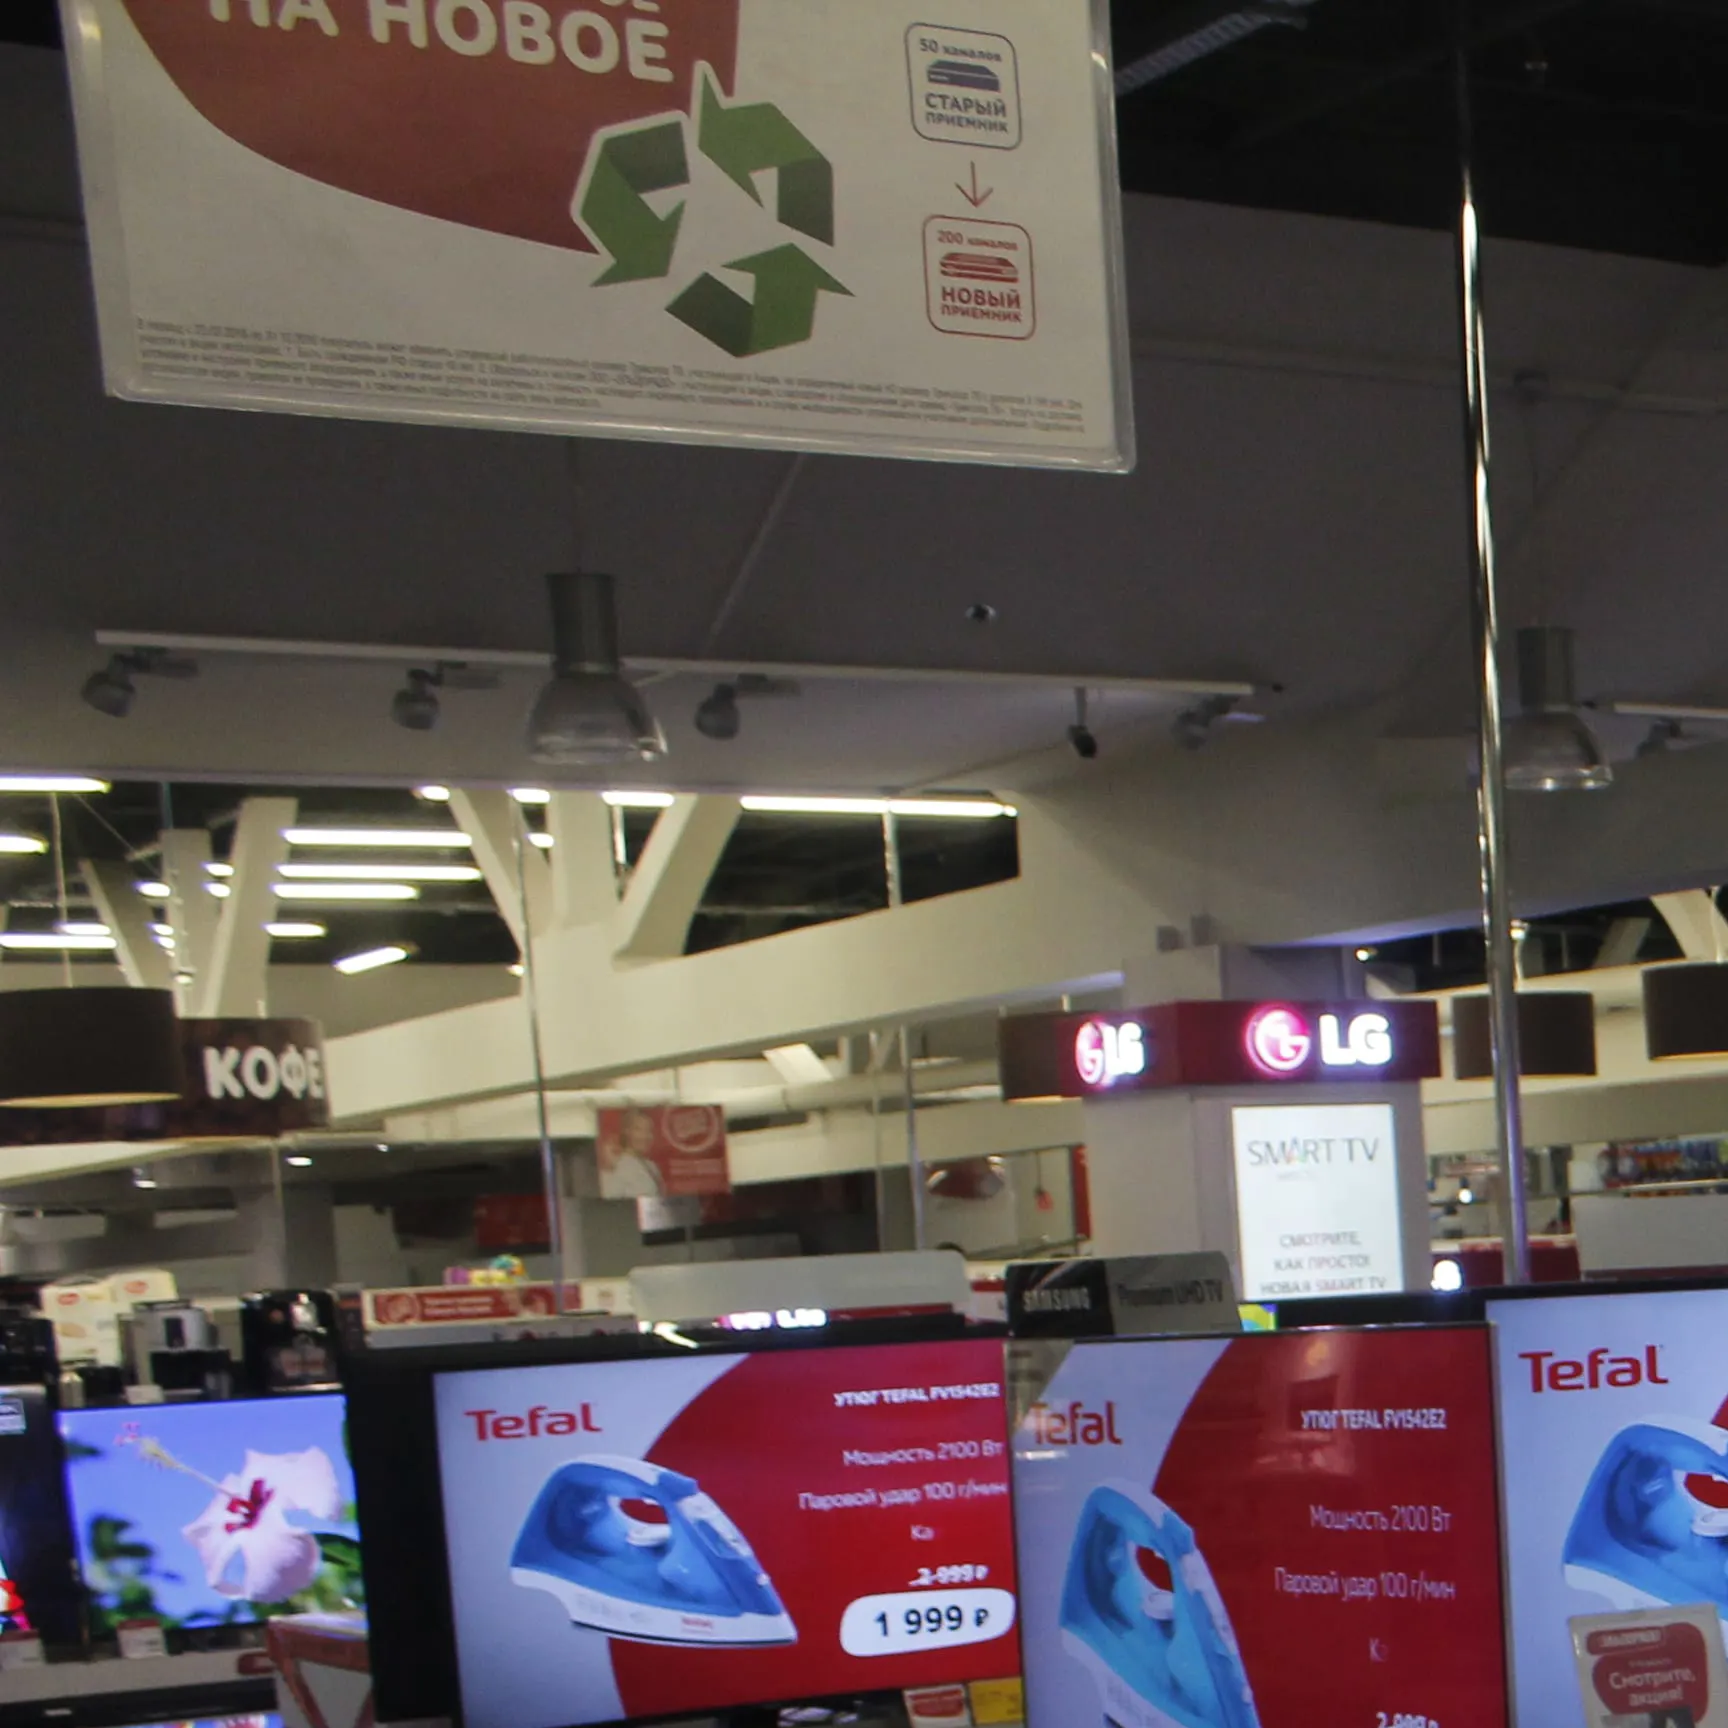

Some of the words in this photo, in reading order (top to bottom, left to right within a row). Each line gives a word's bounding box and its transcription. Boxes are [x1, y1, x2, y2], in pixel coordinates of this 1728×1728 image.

[369, 0, 674, 83] НОВОЕ
[918, 38, 939, 54] 50
[925, 92, 1007, 118] СТАРЫЙ
[937, 230, 964, 246] 200
[940, 286, 1021, 310] НОВЫЙ
[1318, 1013, 1392, 1067] LG
[203, 1044, 324, 1103] КОФЕ
[1246, 1136, 1336, 1167] SMART
[1339, 1136, 1380, 1162] TV
[1022, 1285, 1092, 1314] SAMSUNG
[1519, 1344, 1668, 1393] Tefal
[880, 1387, 929, 1404] TEFAL
[465, 1402, 603, 1441] Tefal
[1030, 1402, 1123, 1446] Tefal
[1301, 1408, 1339, 1430] УТЮГ
[1340, 1408, 1382, 1430] TEFAL
[1383, 1408, 1447, 1430] FV1542E2
[842, 1447, 936, 1466] Мощность
[937, 1440, 979, 1460] 2100
[981, 1439, 1004, 1457] Вт
[798, 1488, 878, 1511] Паровой
[879, 1487, 921, 1508] удар
[923, 1481, 955, 1501] 100
[1309, 1504, 1389, 1531] Мощность
[1391, 1504, 1428, 1531] 2100
[1432, 1505, 1452, 1532] Вт
[1274, 1567, 1339, 1599] Паровой
[1341, 1573, 1377, 1602] удар
[1380, 1572, 1407, 1598] 100
[1410, 1570, 1456, 1601] г/мин
[904, 1605, 963, 1635] 999
